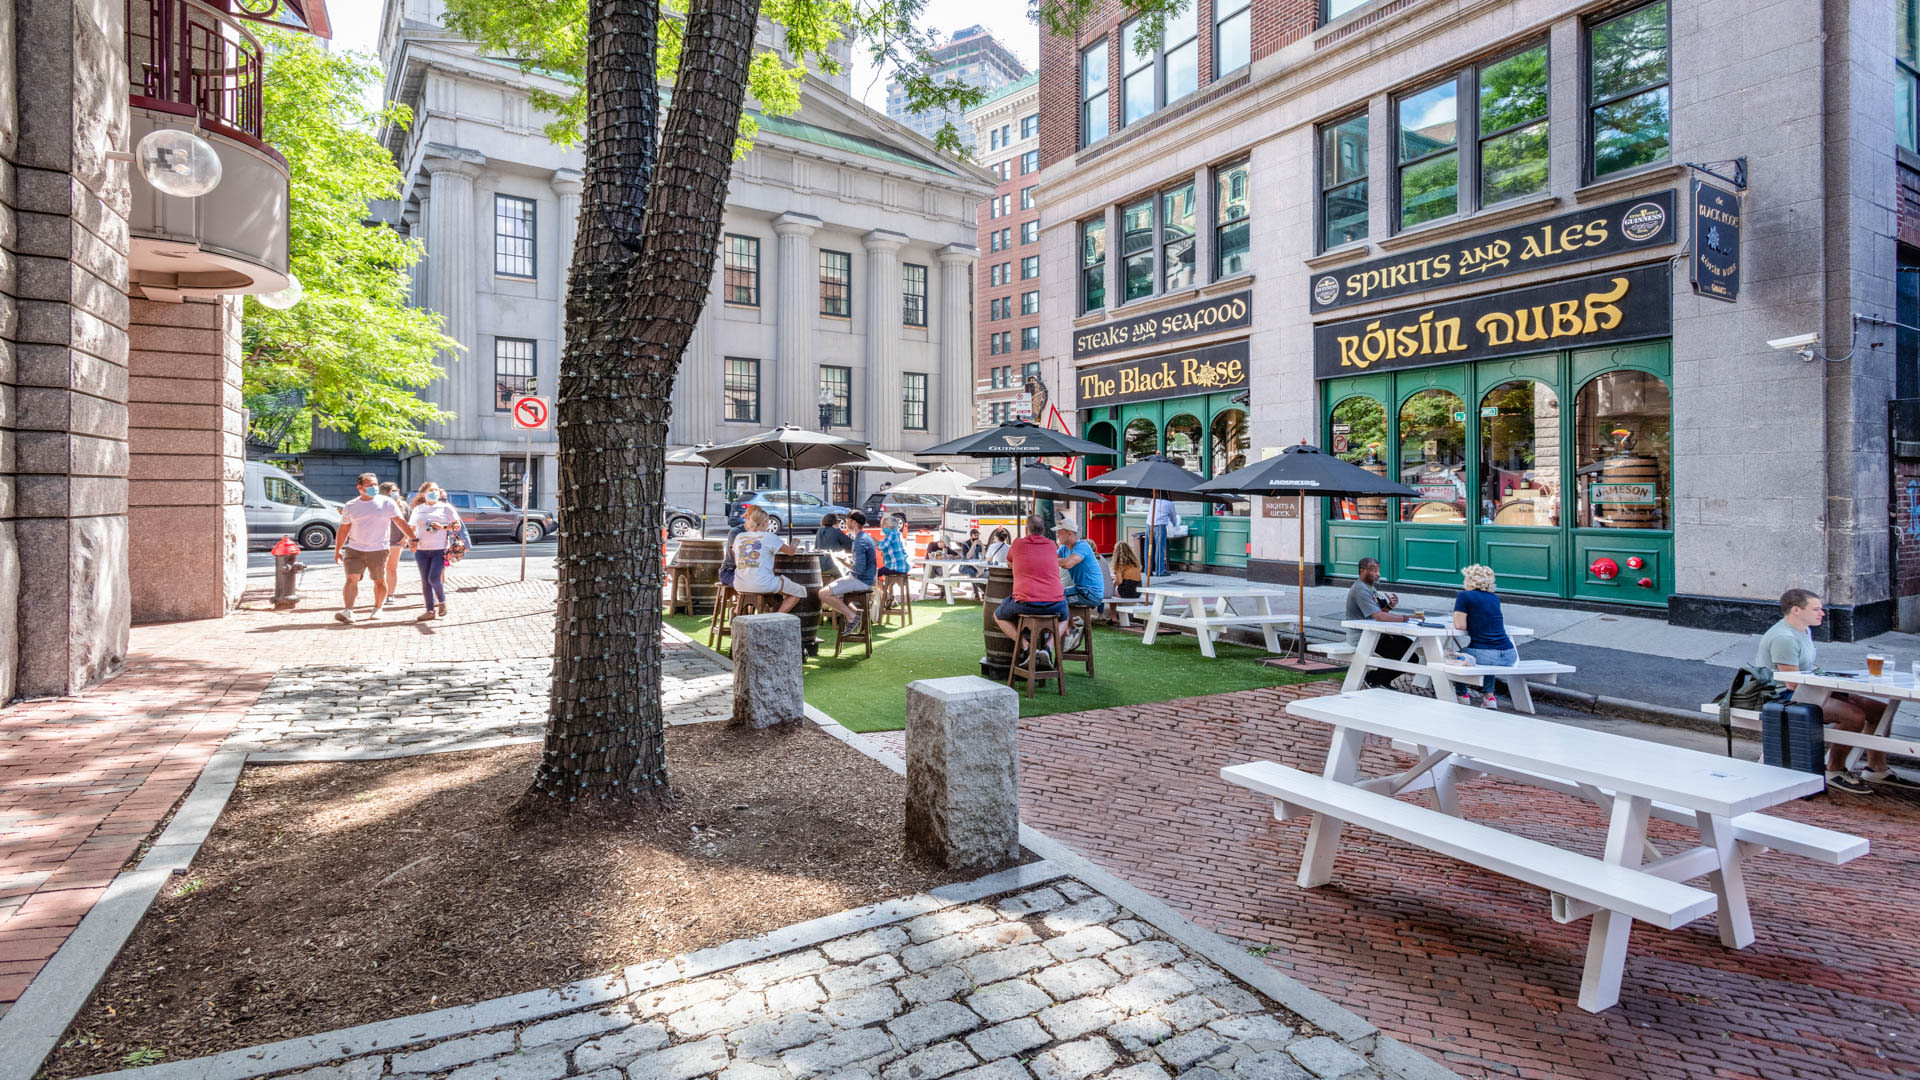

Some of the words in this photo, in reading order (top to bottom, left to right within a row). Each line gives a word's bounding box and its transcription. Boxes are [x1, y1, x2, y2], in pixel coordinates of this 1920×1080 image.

[1624, 213, 1662, 225] GUINNESS
[1699, 204, 1721, 222] BLACK
[1346, 255, 1450, 297] SPIRITS
[1459, 239, 1511, 267] AND
[1519, 219, 1608, 260] ALES
[1078, 326, 1129, 352] STEAKS
[1132, 318, 1158, 337] AND
[1161, 298, 1247, 335] SEAFOOD
[1475, 277, 1630, 347] DUBH
[1080, 374, 1116, 400] The
[1119, 362, 1177, 395] Black
[1595, 485, 1649, 497] JAMESON
